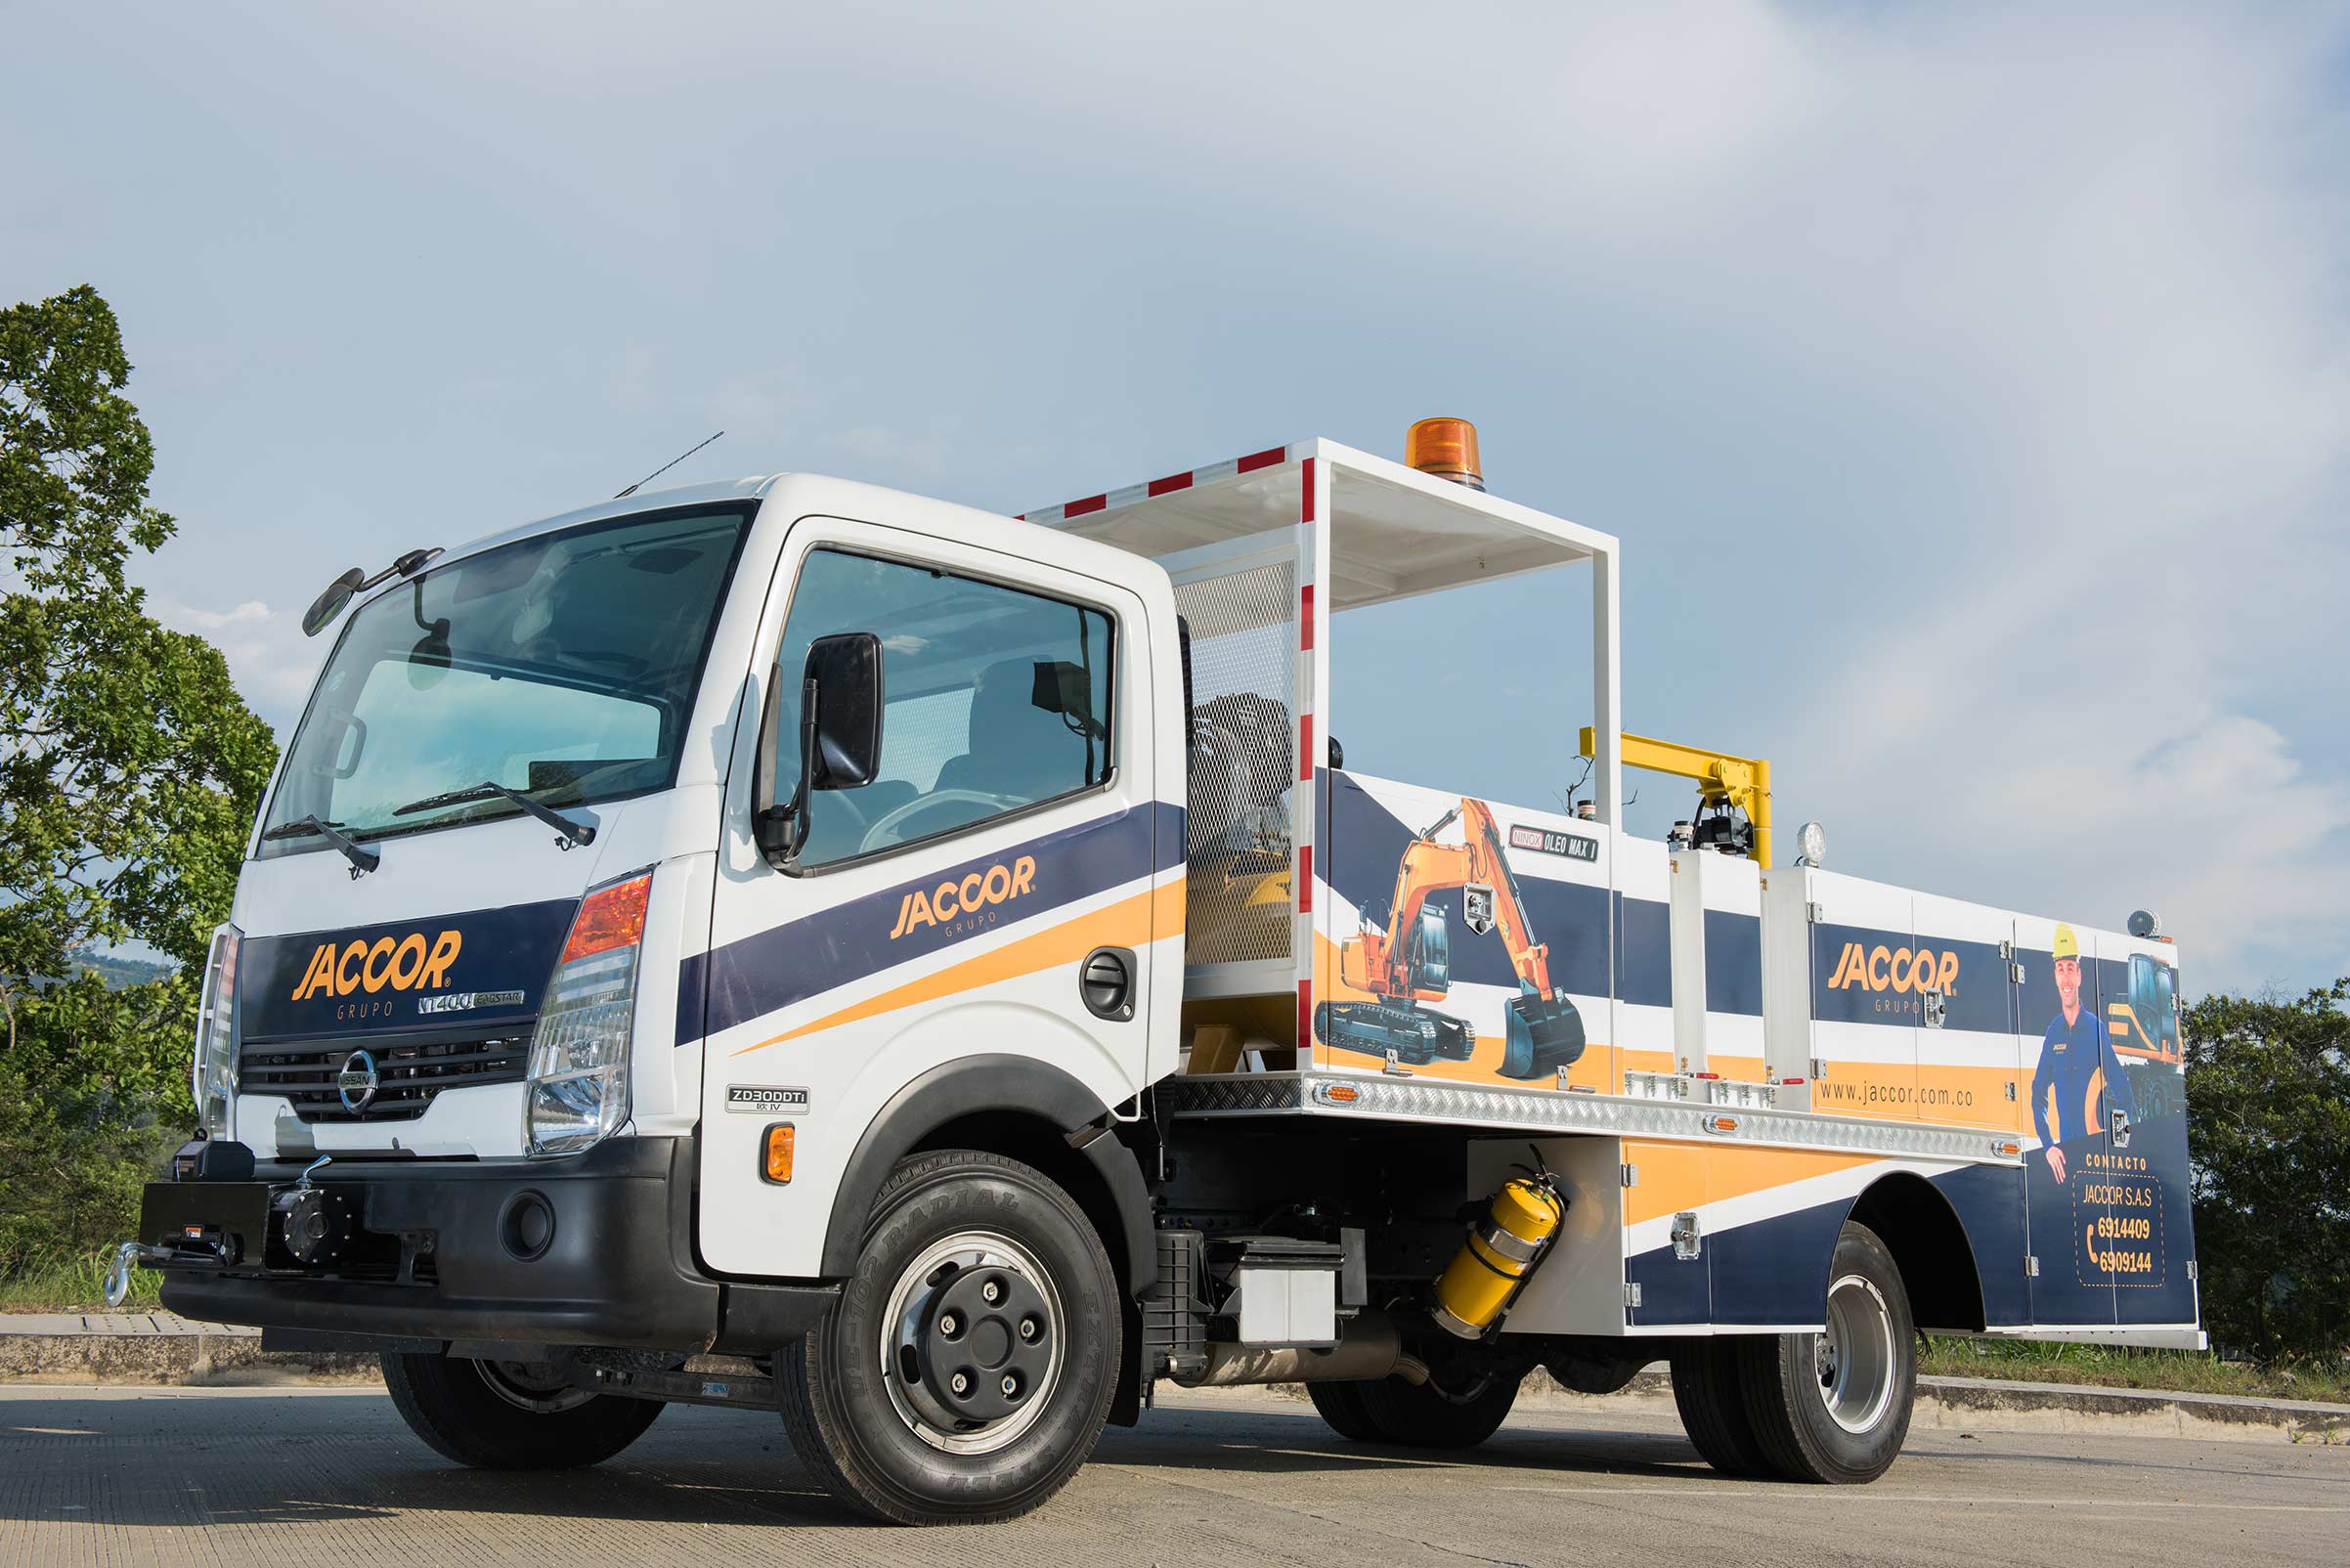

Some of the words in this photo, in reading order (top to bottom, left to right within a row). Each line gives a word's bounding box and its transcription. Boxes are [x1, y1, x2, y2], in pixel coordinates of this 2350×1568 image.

[1545, 833, 1567, 853] OLEO
[1568, 838, 1588, 857] MAX
[890, 854, 1036, 939] JACCOR
[945, 911, 997, 937] GRUPO
[291, 930, 462, 1001] JACCOR
[1827, 942, 1960, 996] JACCOR
[337, 1001, 393, 1021] GRUPO
[1875, 999, 1920, 1014] GRUPO
[1820, 1080, 1973, 1107] www.jaccor.com.co
[2085, 1153, 2147, 1171] CONTACTO
[2083, 1184, 2122, 1205] JACCOR
[2125, 1187, 2152, 1207] S.A.S
[882, 1188, 1020, 1252] RADIAL
[2098, 1216, 2151, 1240] 6914409
[2100, 1251, 2152, 1273] 6909144
